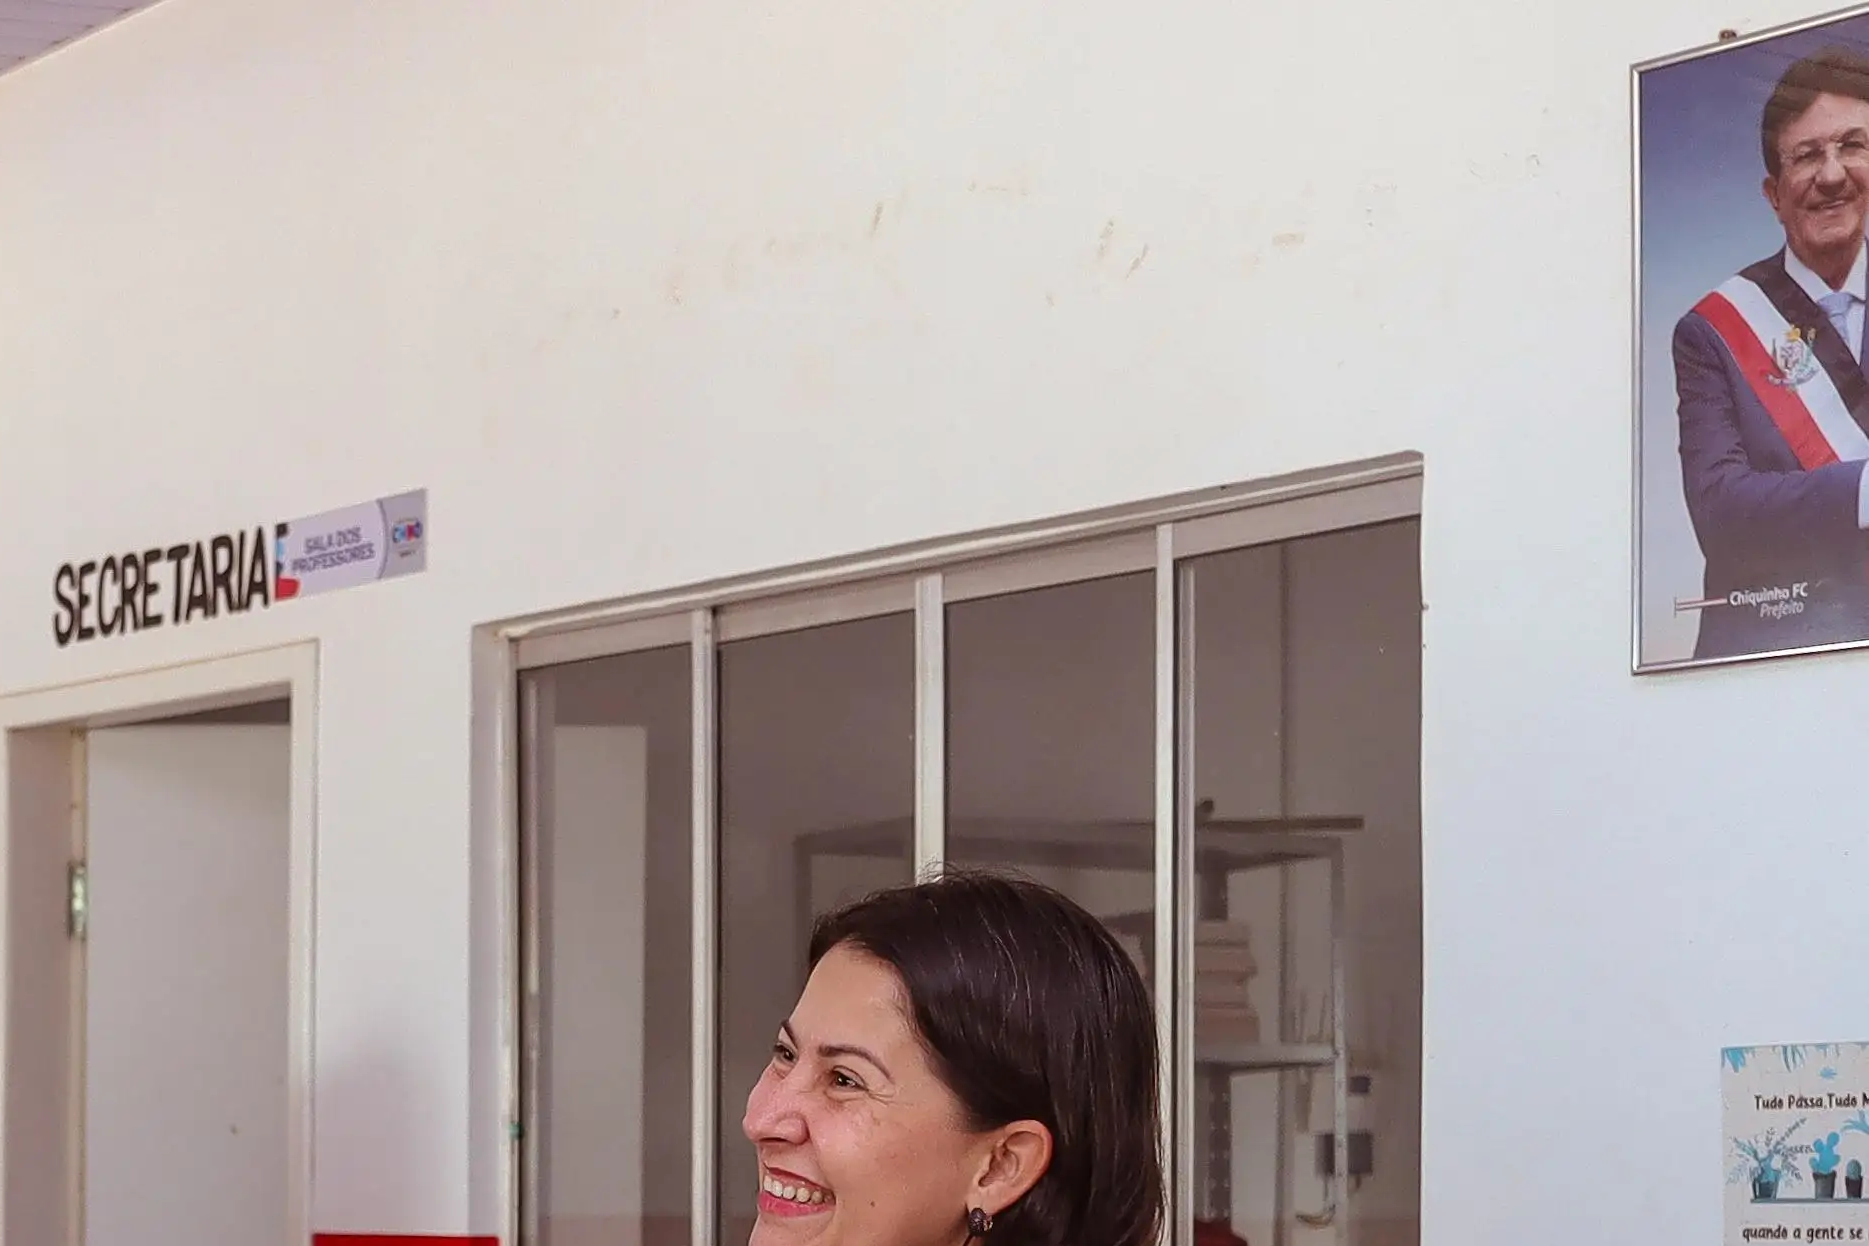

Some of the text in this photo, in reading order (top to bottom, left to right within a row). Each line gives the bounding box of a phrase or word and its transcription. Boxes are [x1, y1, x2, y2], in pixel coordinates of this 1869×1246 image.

[304, 526, 362, 554] SALA DOS
[291, 542, 376, 572] PROFESSORES
[52, 526, 270, 647] SECRETARIA
[1730, 582, 1808, 607] Chiquinho FC
[1760, 600, 1804, 620] Prefeito
[1754, 1094, 1784, 1110] Tudo
[1742, 1224, 1863, 1244] quando a gente se
